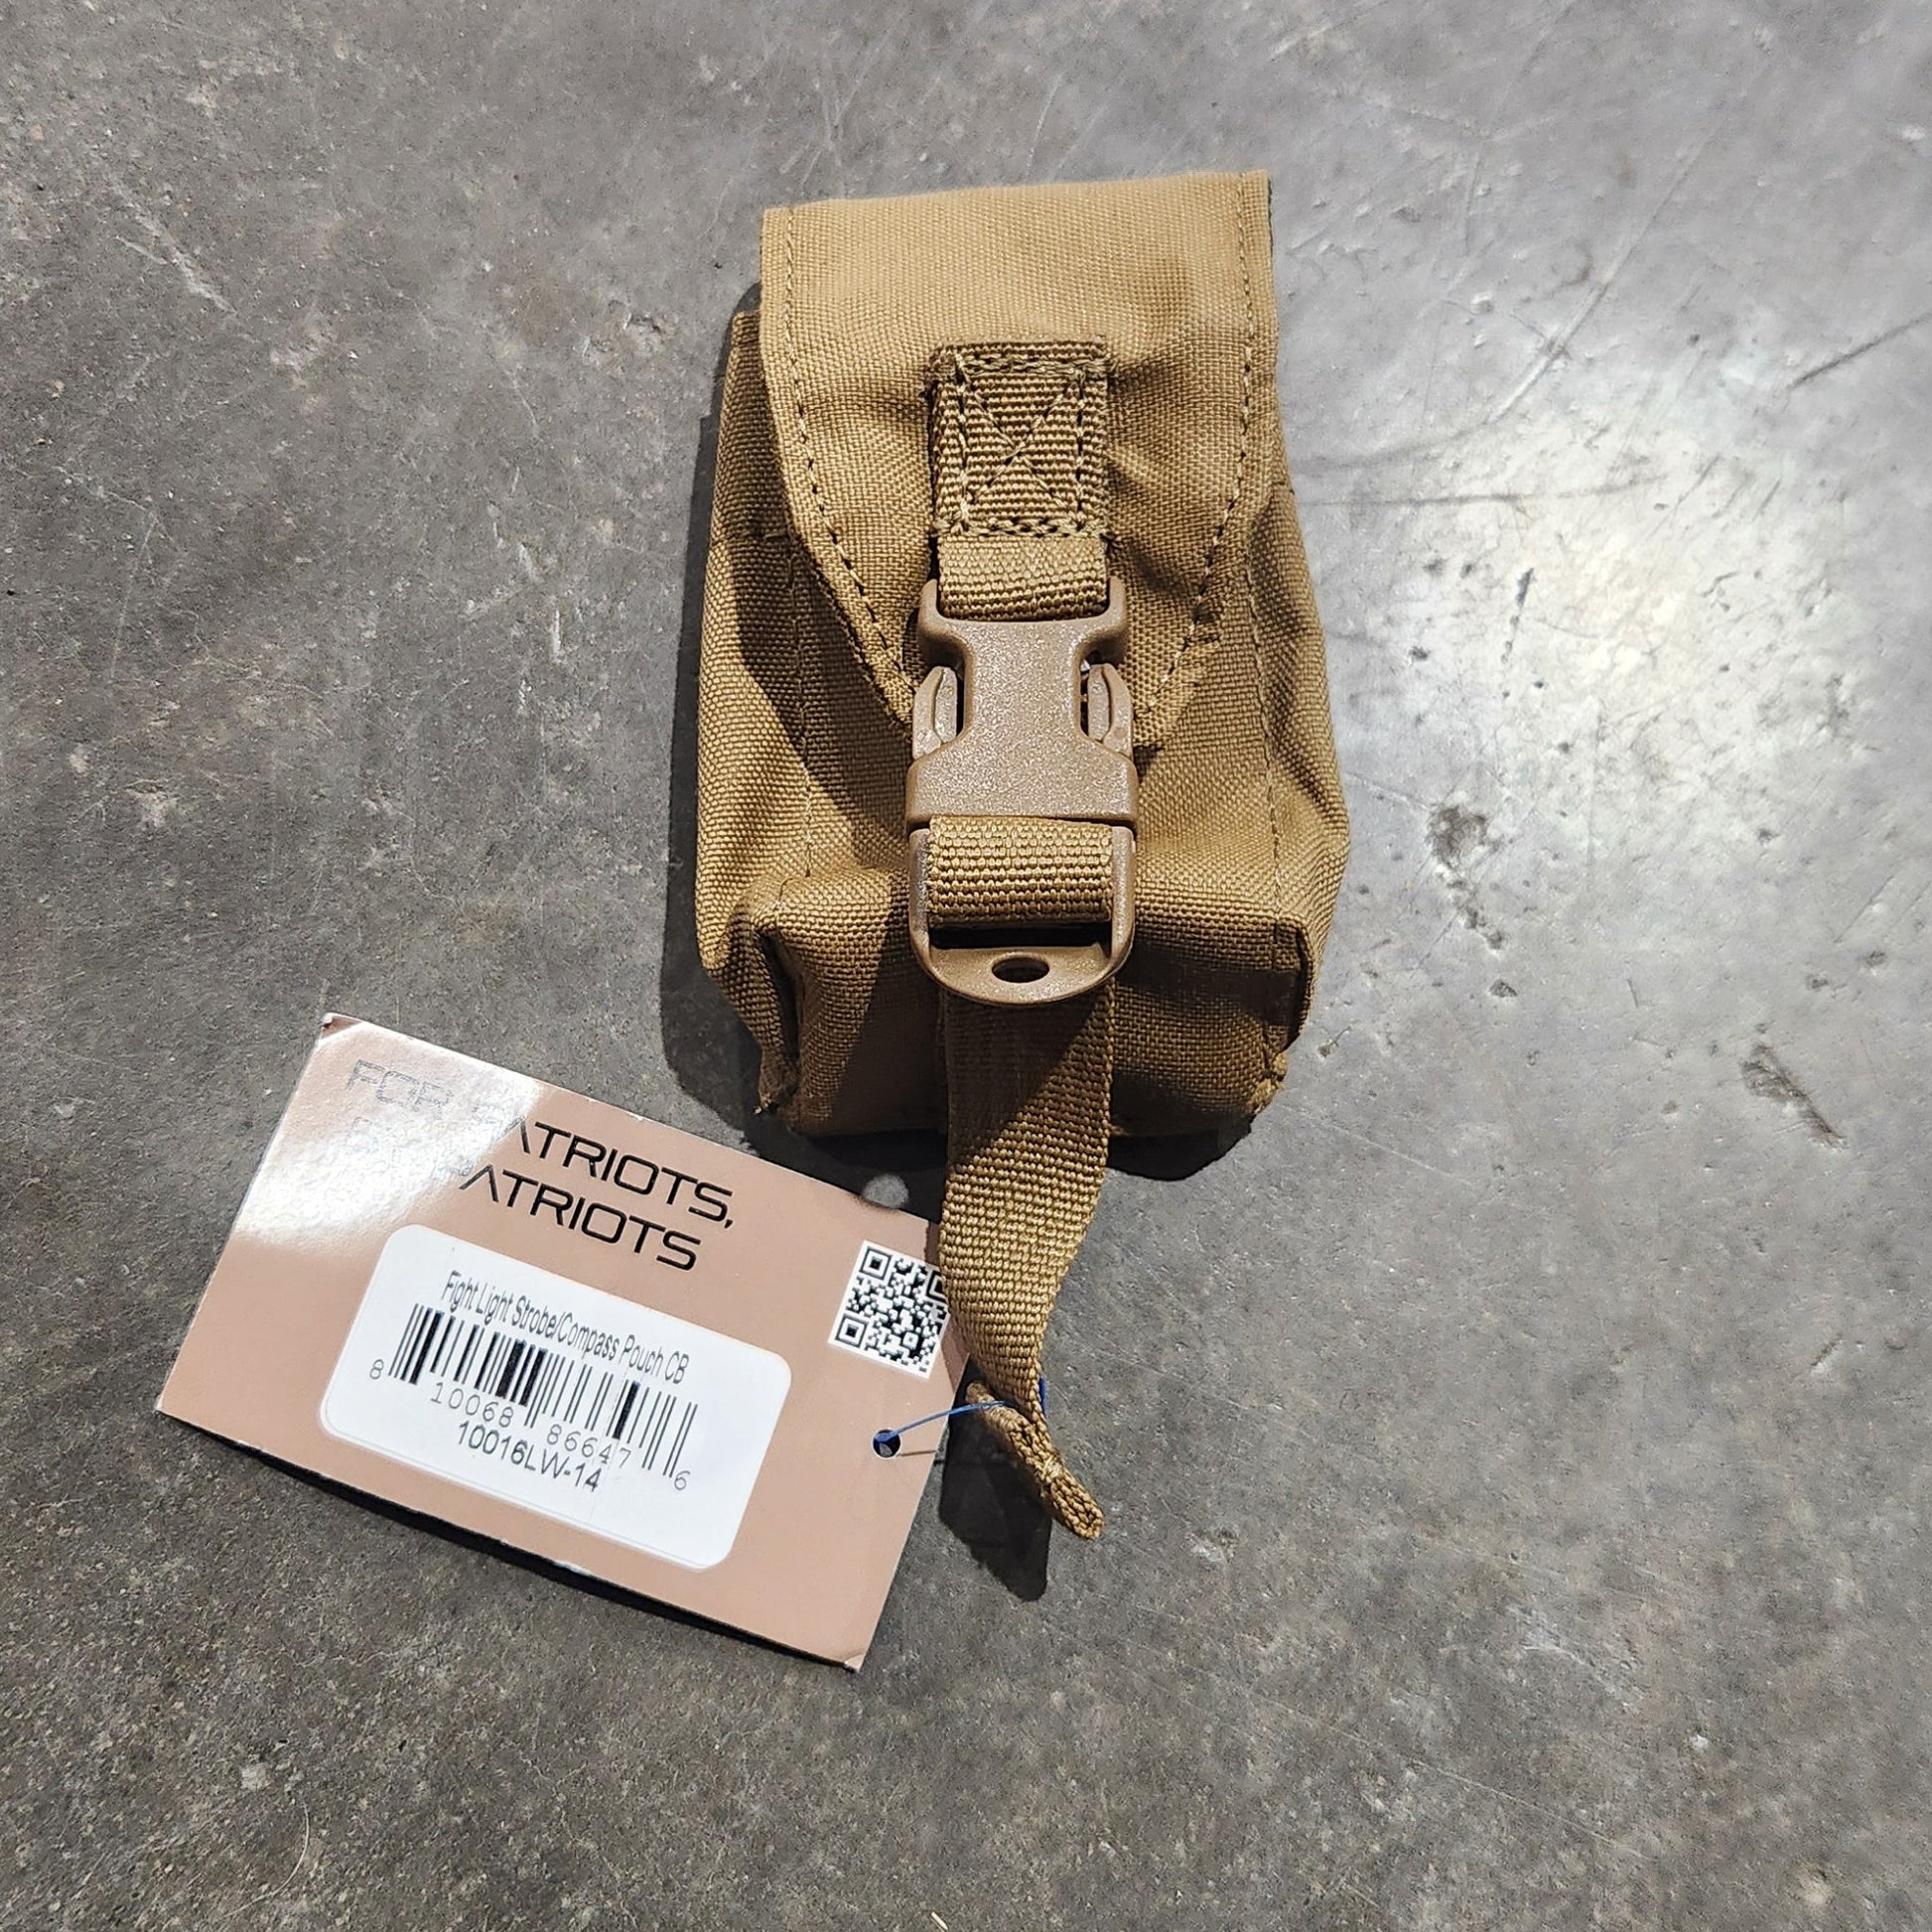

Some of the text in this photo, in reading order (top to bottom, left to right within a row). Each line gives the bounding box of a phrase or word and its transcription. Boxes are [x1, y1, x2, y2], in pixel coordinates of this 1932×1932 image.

[345, 1058, 454, 1120] FOR
[441, 1270, 690, 1384] Fight Light Strobe/Compass Pouch CB
[368, 1358, 692, 1491] 8 10068 86647 6
[458, 1421, 603, 1492] 10016LW-14
